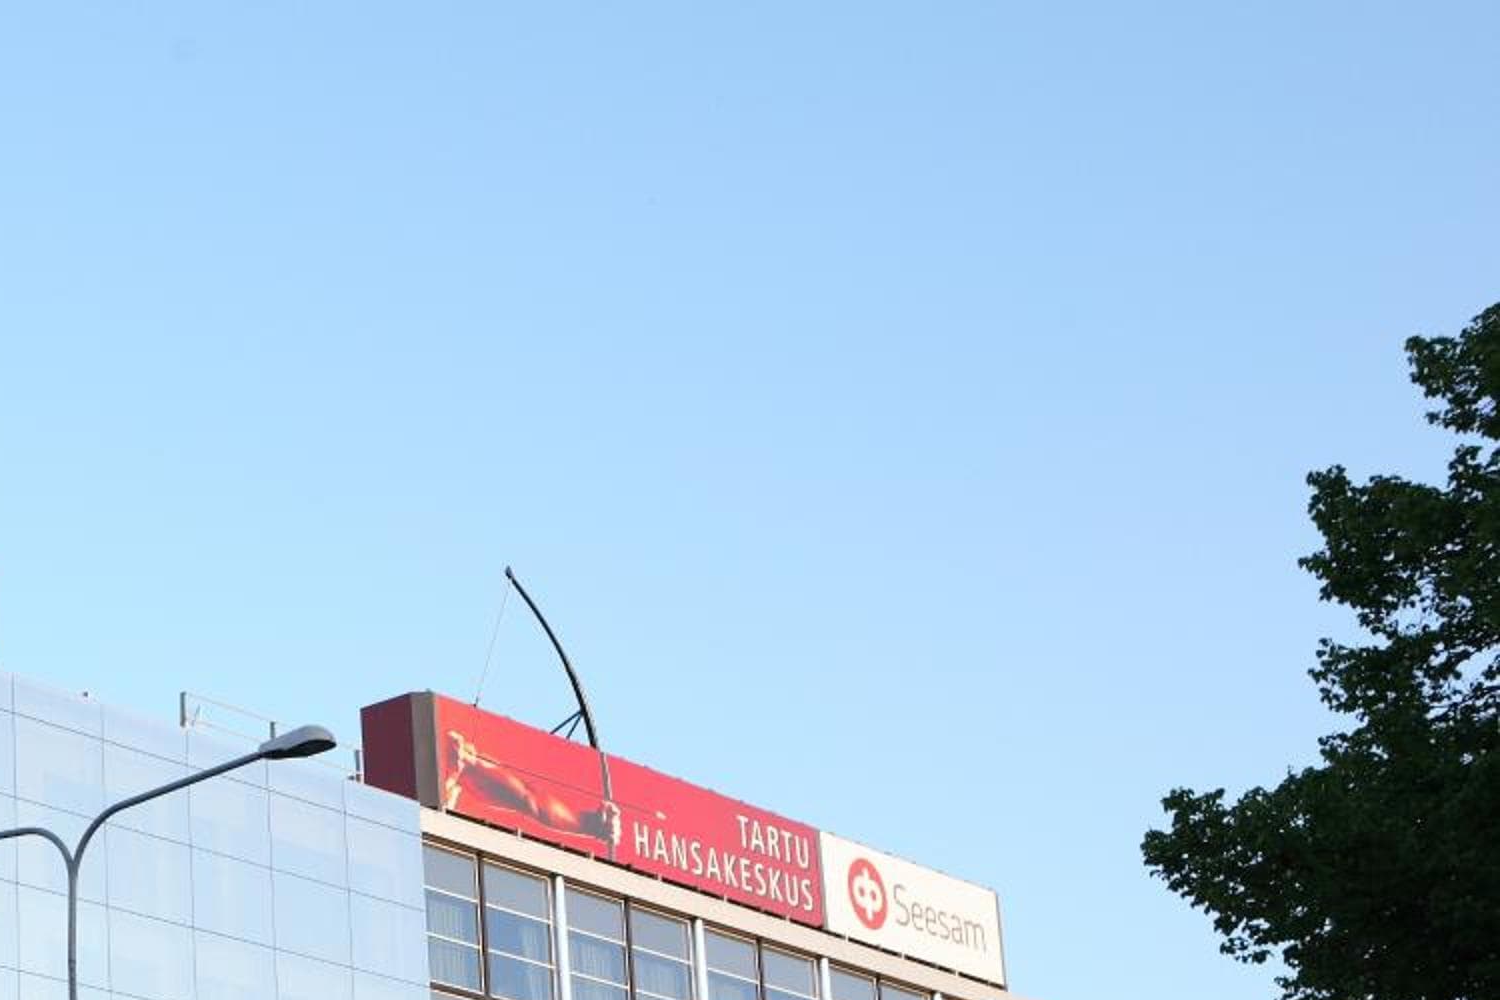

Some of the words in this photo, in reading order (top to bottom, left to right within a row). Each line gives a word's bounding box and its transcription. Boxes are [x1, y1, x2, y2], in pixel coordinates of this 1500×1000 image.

[633, 821, 813, 912] HANSAKESKUS
[736, 815, 809, 869] TARTU
[892, 884, 987, 952] Seesam
